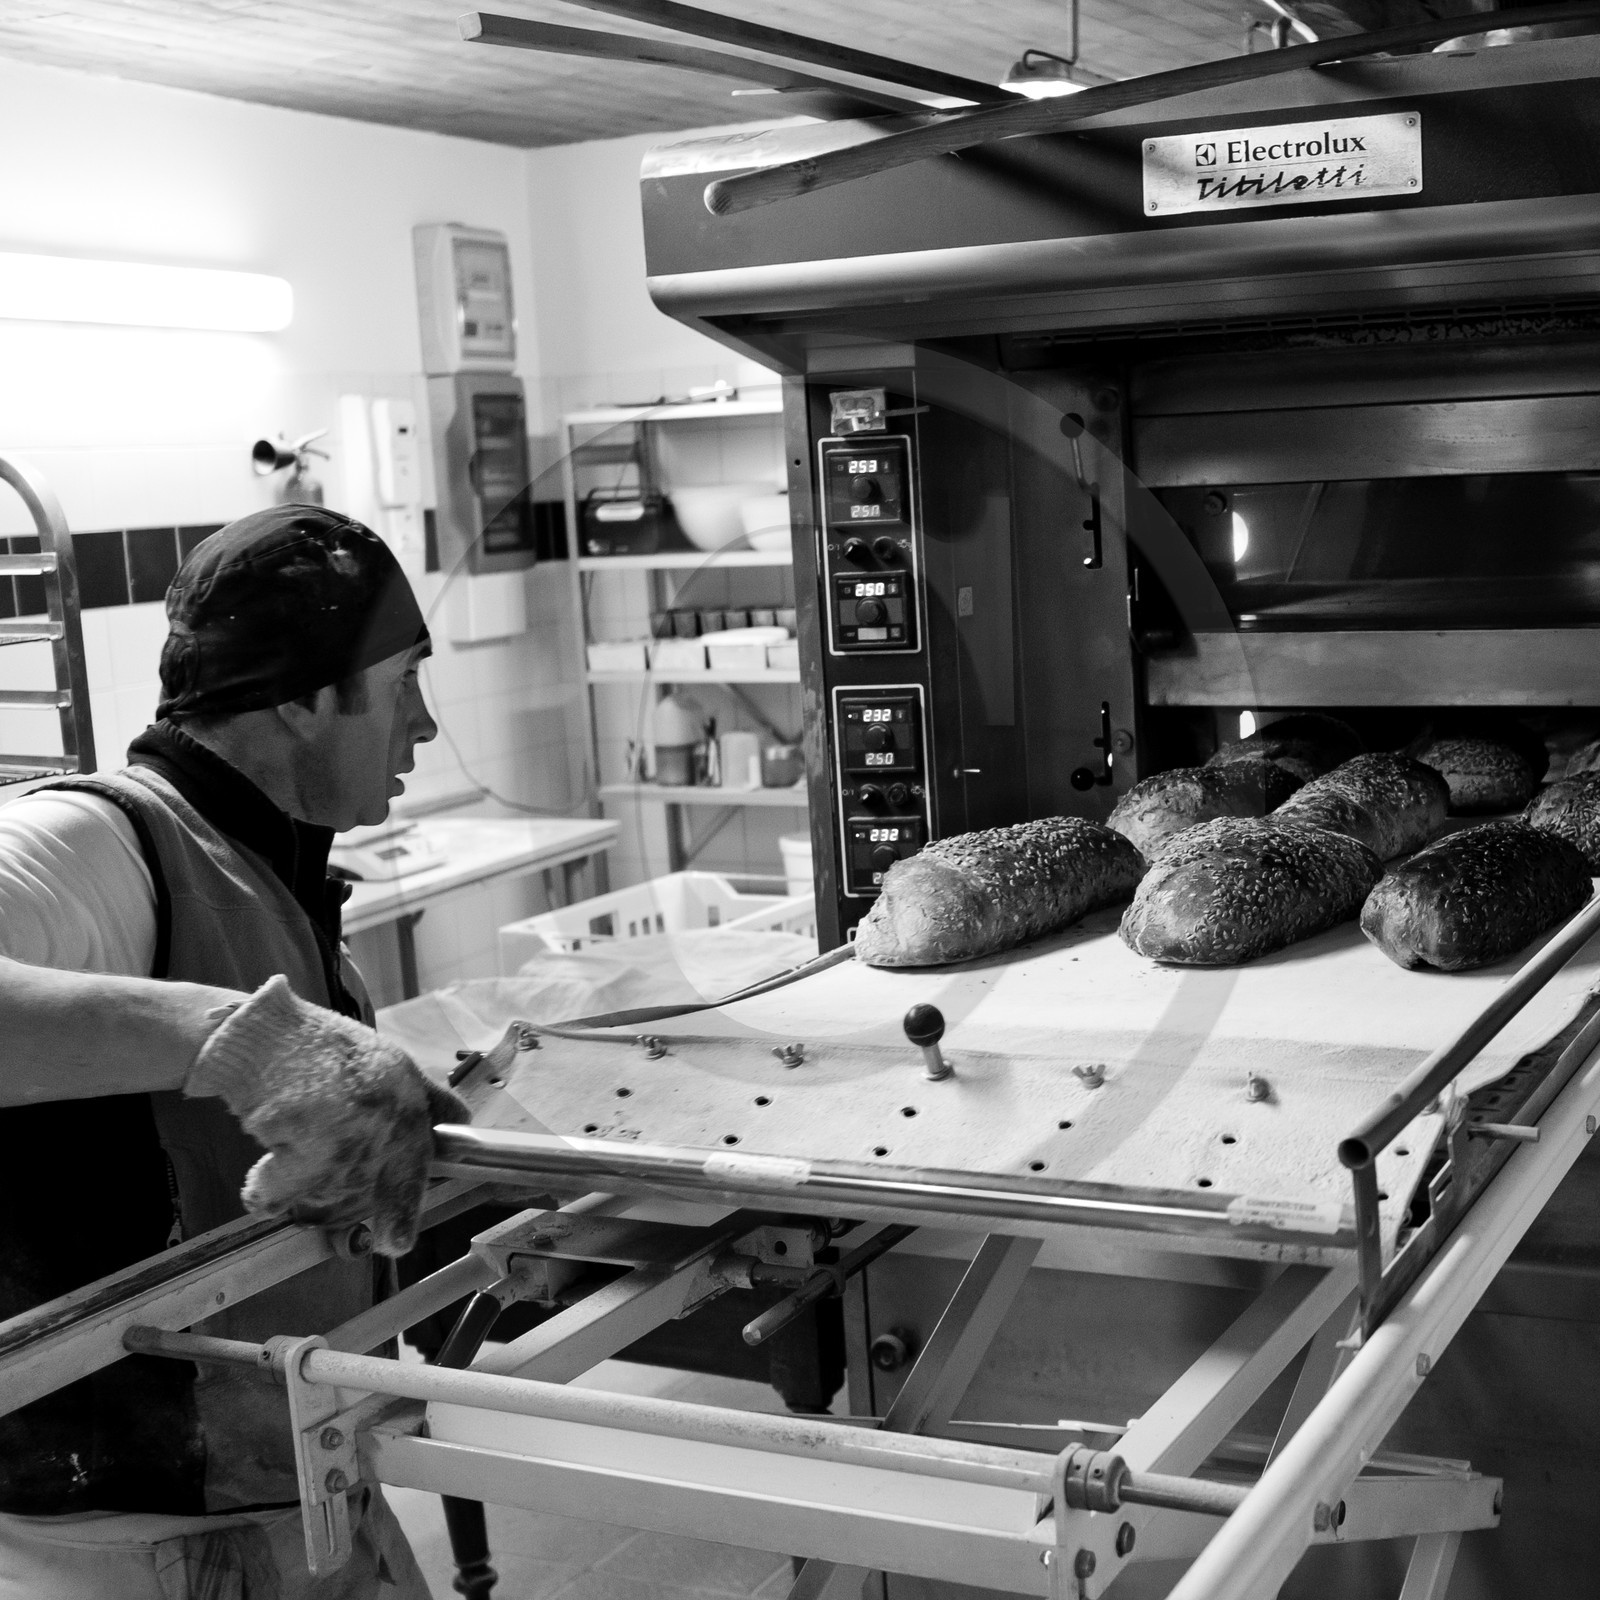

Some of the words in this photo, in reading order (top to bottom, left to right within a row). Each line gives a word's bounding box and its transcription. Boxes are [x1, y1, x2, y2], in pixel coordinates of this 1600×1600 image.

[1227, 131, 1367, 164] Electrolux
[849, 460, 877, 473] 253
[855, 582, 885, 597] 250
[863, 708, 892, 722] 232
[865, 752, 894, 765] 250
[870, 828, 899, 841] 232
